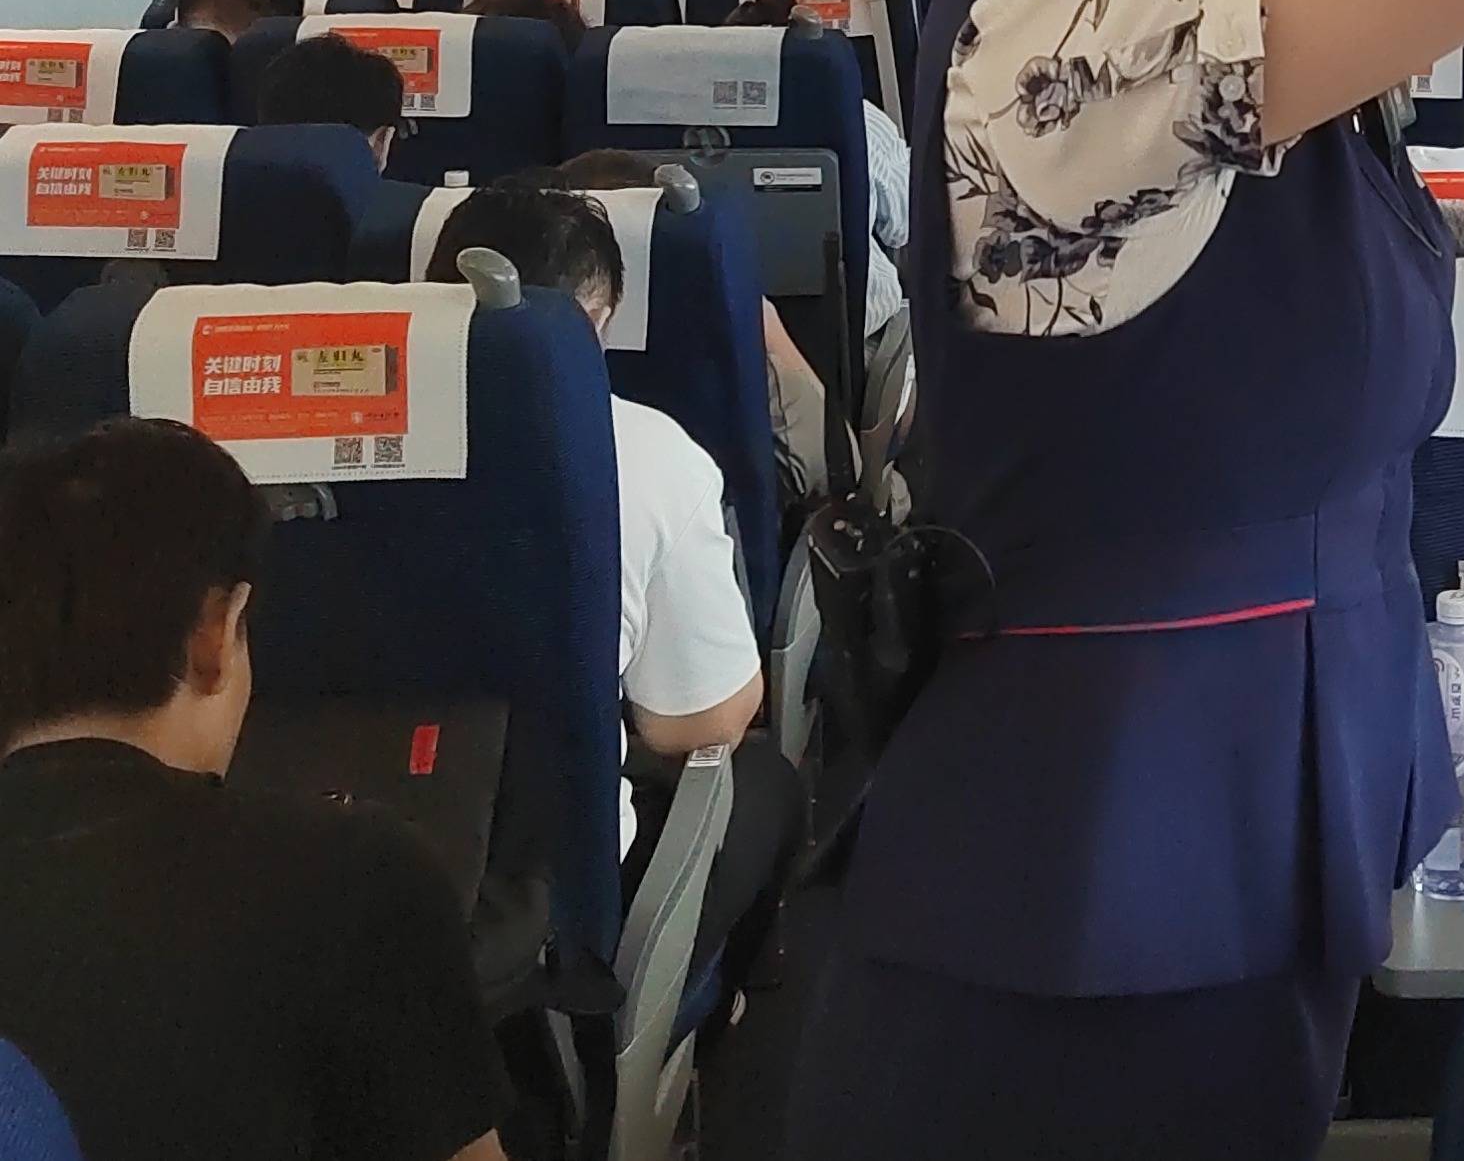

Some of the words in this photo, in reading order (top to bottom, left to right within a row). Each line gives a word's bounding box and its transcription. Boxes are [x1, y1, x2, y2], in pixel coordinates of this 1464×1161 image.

[37, 166, 93, 181] 关键时刻
[204, 354, 282, 375] 关键时刻
[203, 376, 283, 397] 自信由我
